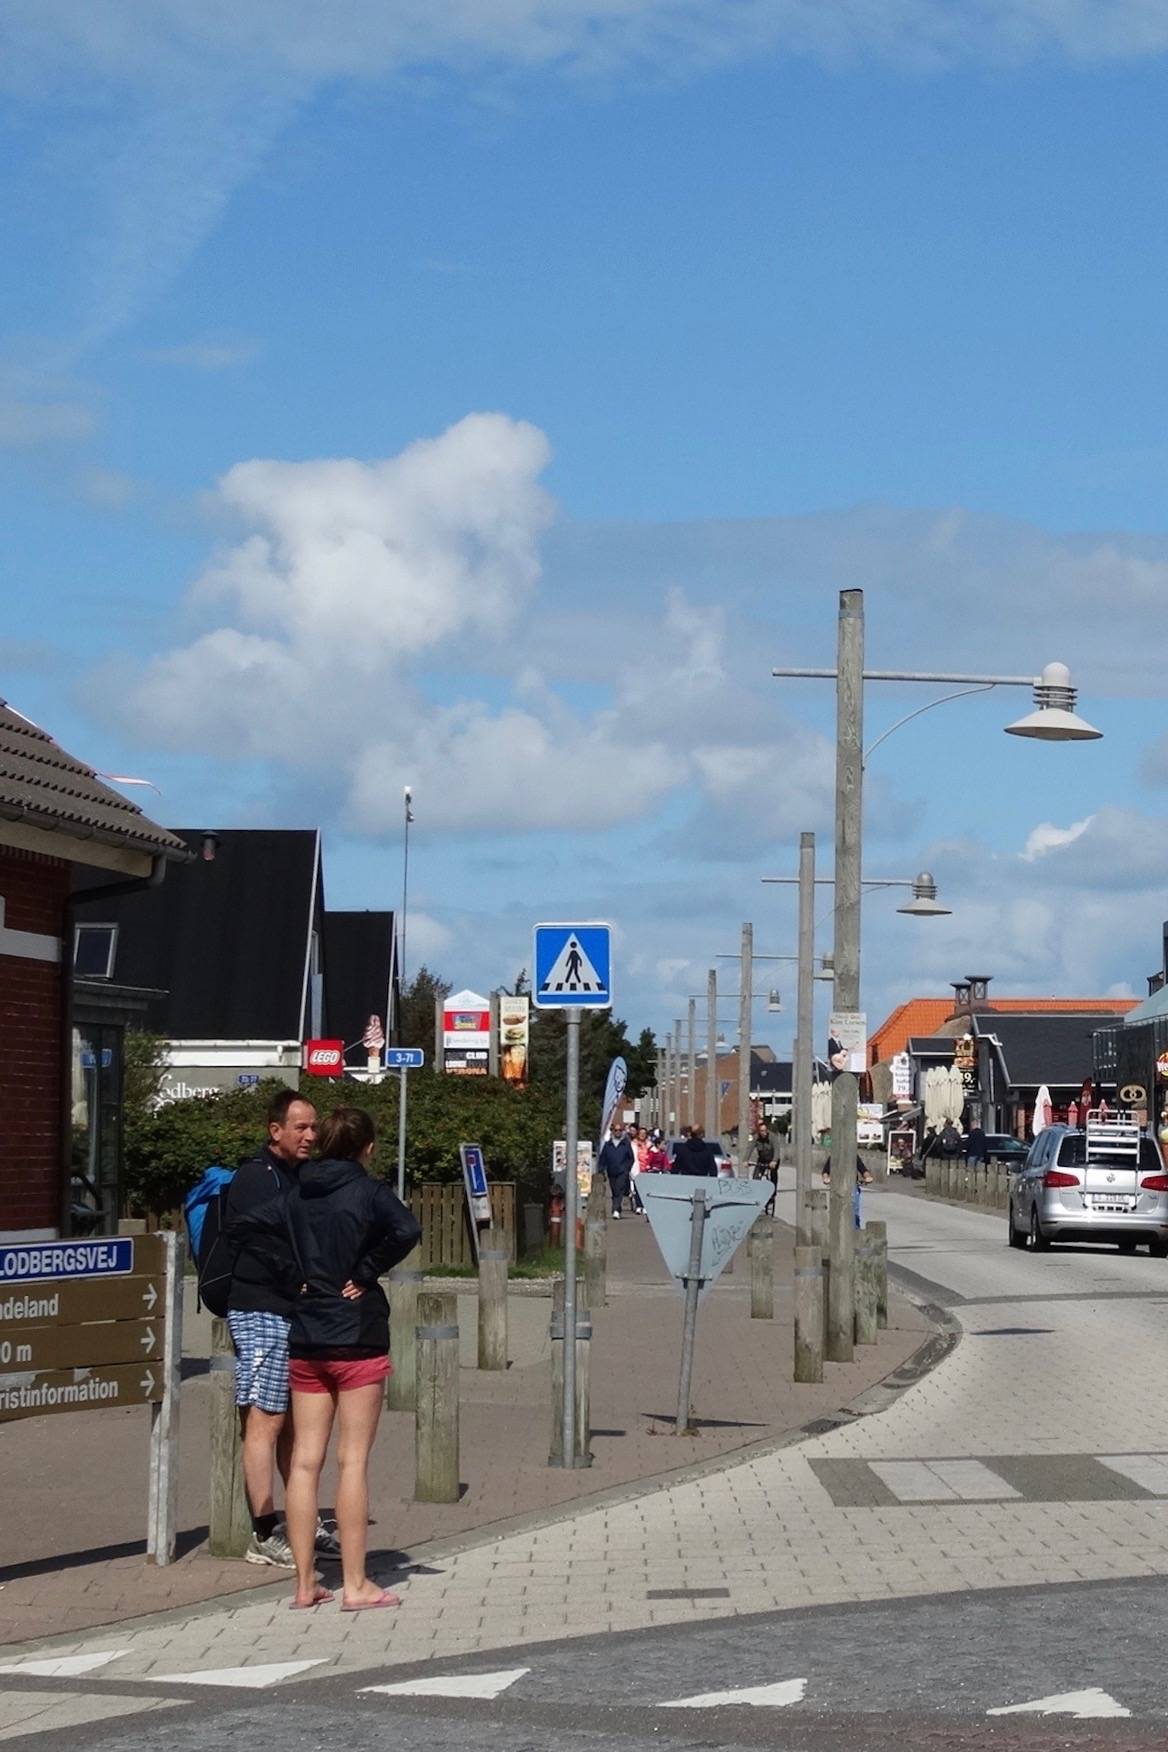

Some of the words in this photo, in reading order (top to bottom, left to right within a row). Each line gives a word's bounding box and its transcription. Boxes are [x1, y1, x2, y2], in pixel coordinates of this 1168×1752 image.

[311, 1051, 339, 1064] LEGO
[396, 1053, 414, 1063] 3-71
[17, 1344, 32, 1361] m
